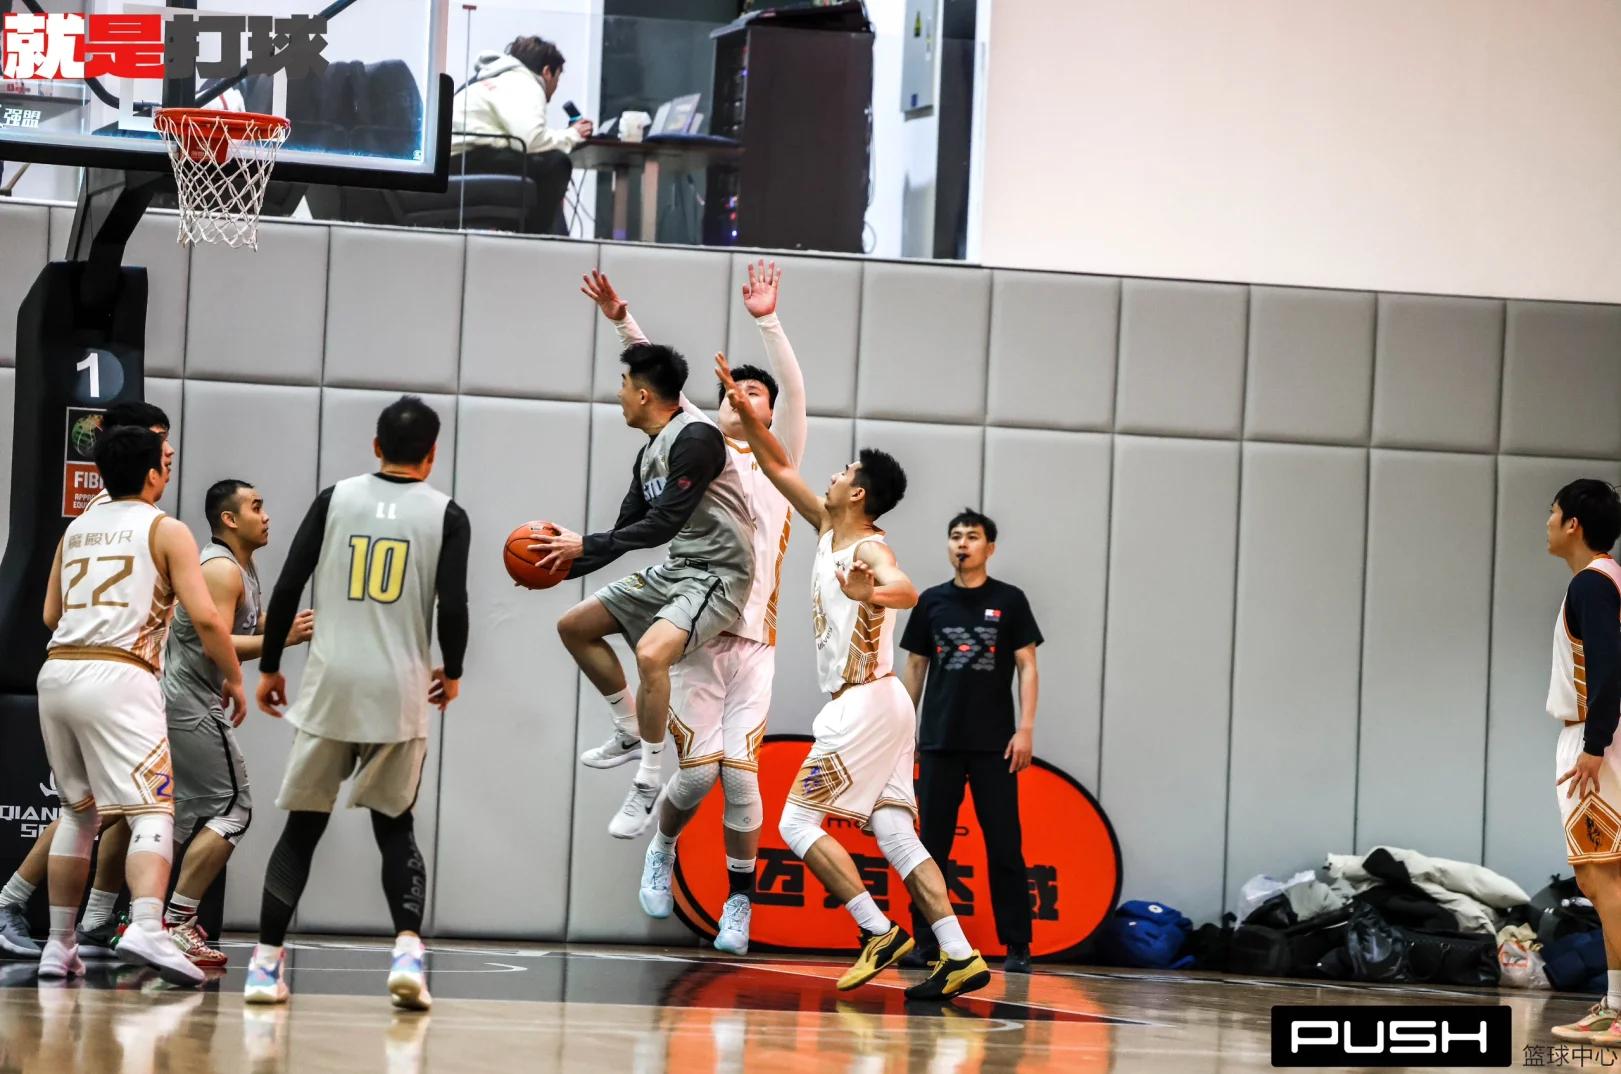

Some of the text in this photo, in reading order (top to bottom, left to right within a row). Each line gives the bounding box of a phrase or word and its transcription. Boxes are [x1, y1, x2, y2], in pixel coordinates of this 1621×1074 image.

[76, 352, 100, 398] 1
[63, 555, 136, 613] 22
[347, 534, 411, 604] 10
[0, 805, 61, 821] QIAN
